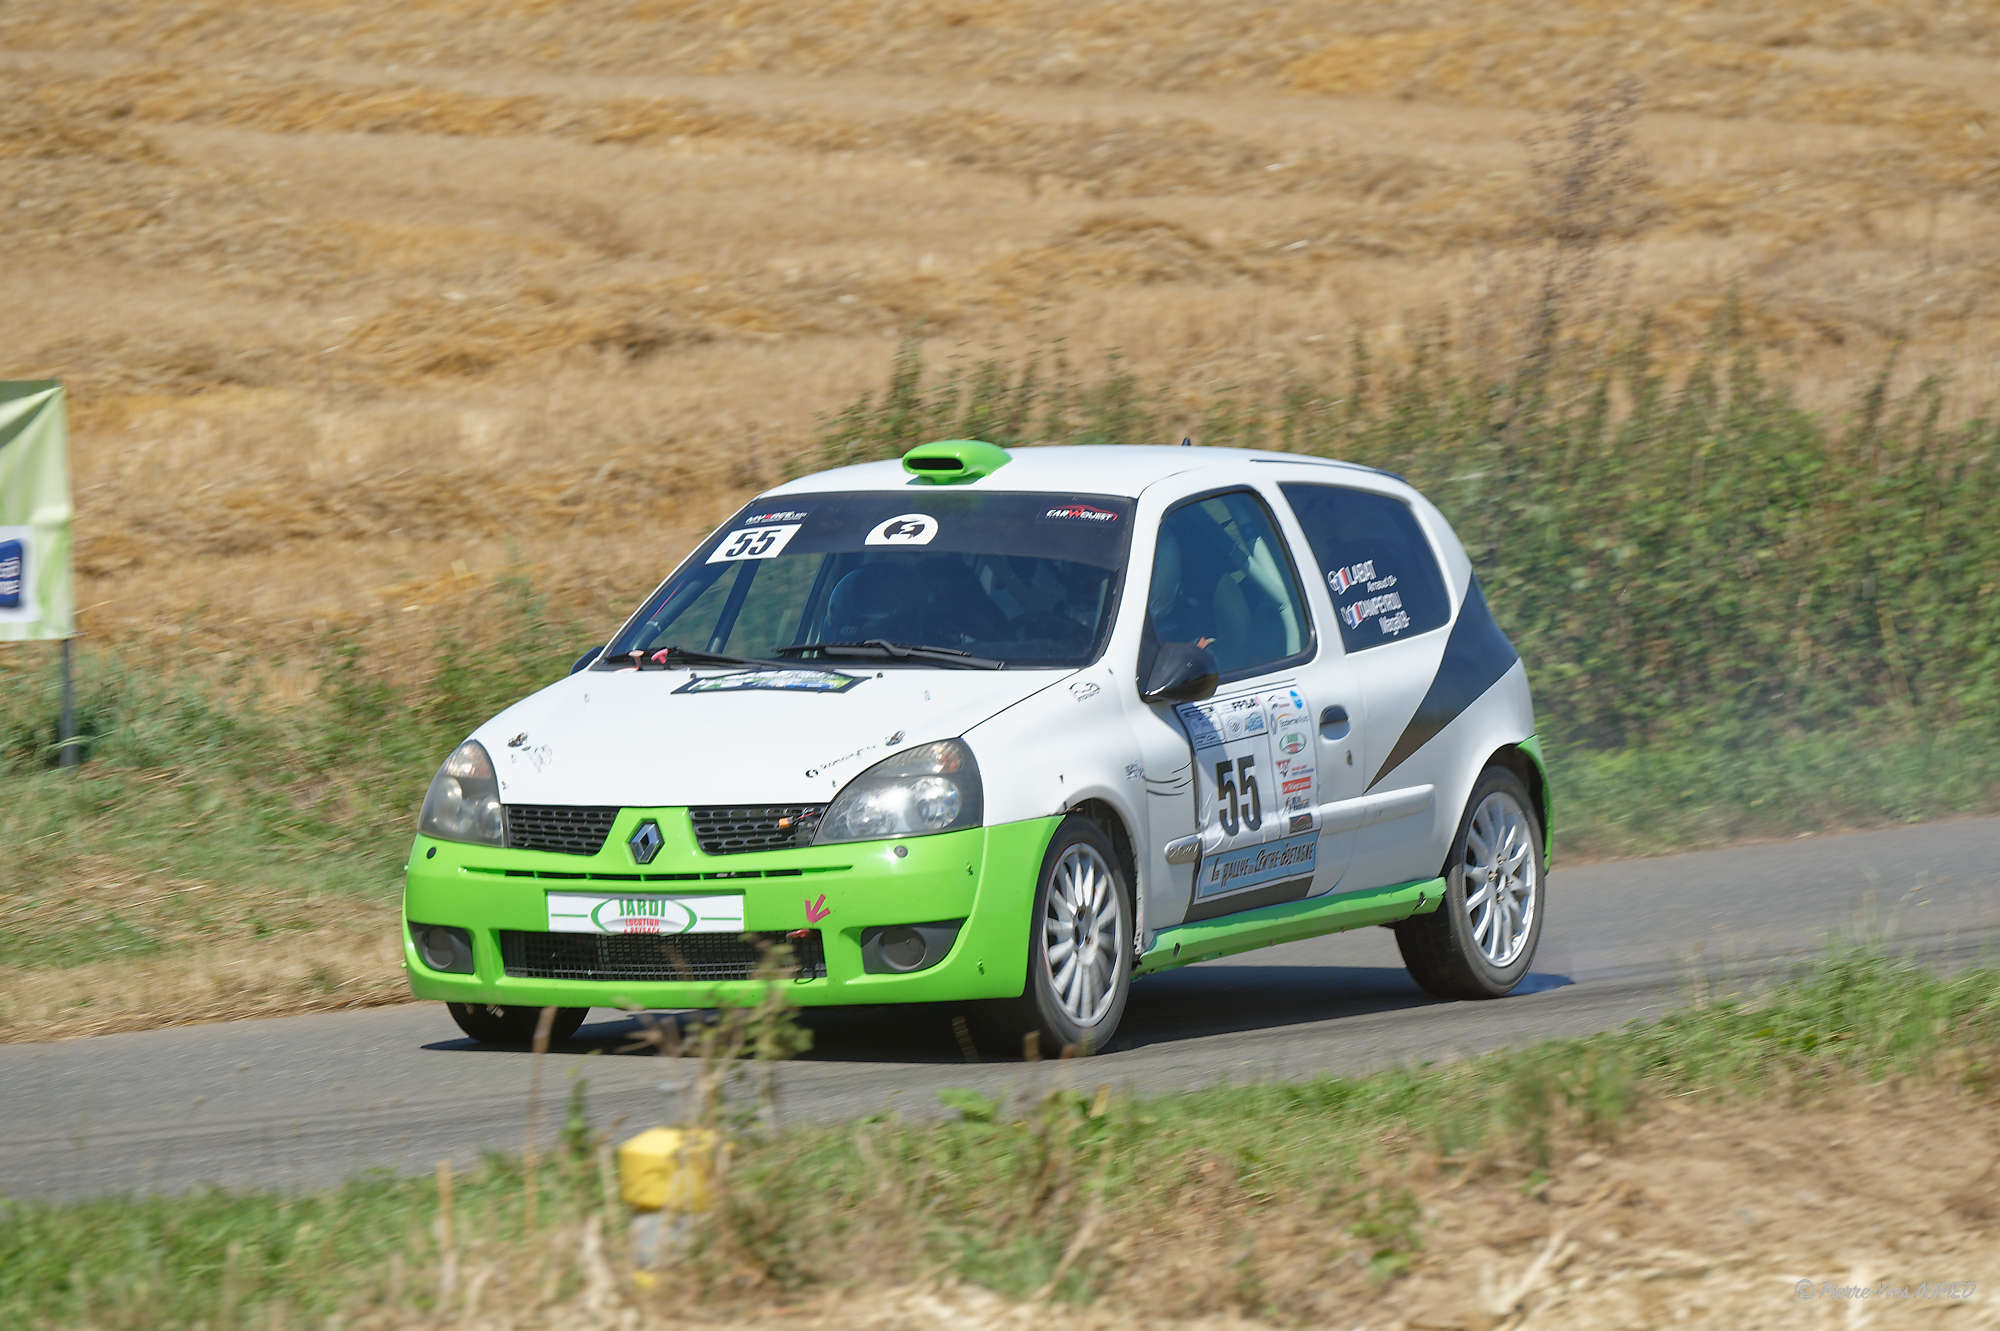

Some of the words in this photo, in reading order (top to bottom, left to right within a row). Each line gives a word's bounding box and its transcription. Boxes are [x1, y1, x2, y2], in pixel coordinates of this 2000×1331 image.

[725, 529, 781, 557] 55
[1345, 560, 1376, 586] LABAT
[1216, 755, 1262, 837] 55
[618, 897, 666, 917] JARDI
[624, 918, 660, 927] LOCATION
